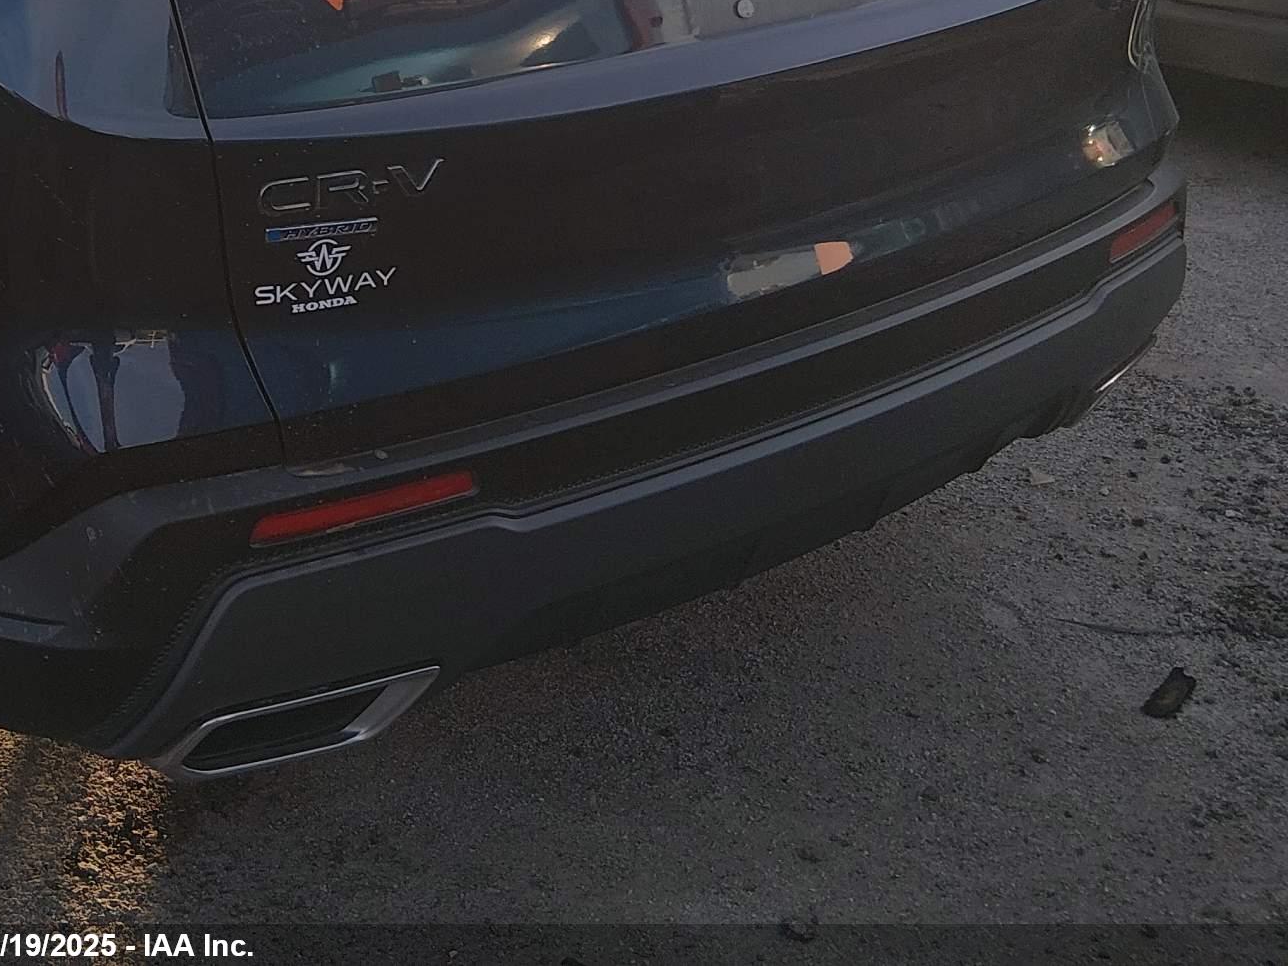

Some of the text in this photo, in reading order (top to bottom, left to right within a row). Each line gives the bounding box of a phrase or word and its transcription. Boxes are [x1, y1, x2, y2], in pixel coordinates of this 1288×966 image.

[258, 158, 444, 217] CR-V
[282, 220, 377, 241] HYBRID
[254, 267, 397, 306] SKYWAY
[291, 295, 358, 314] HONDA
